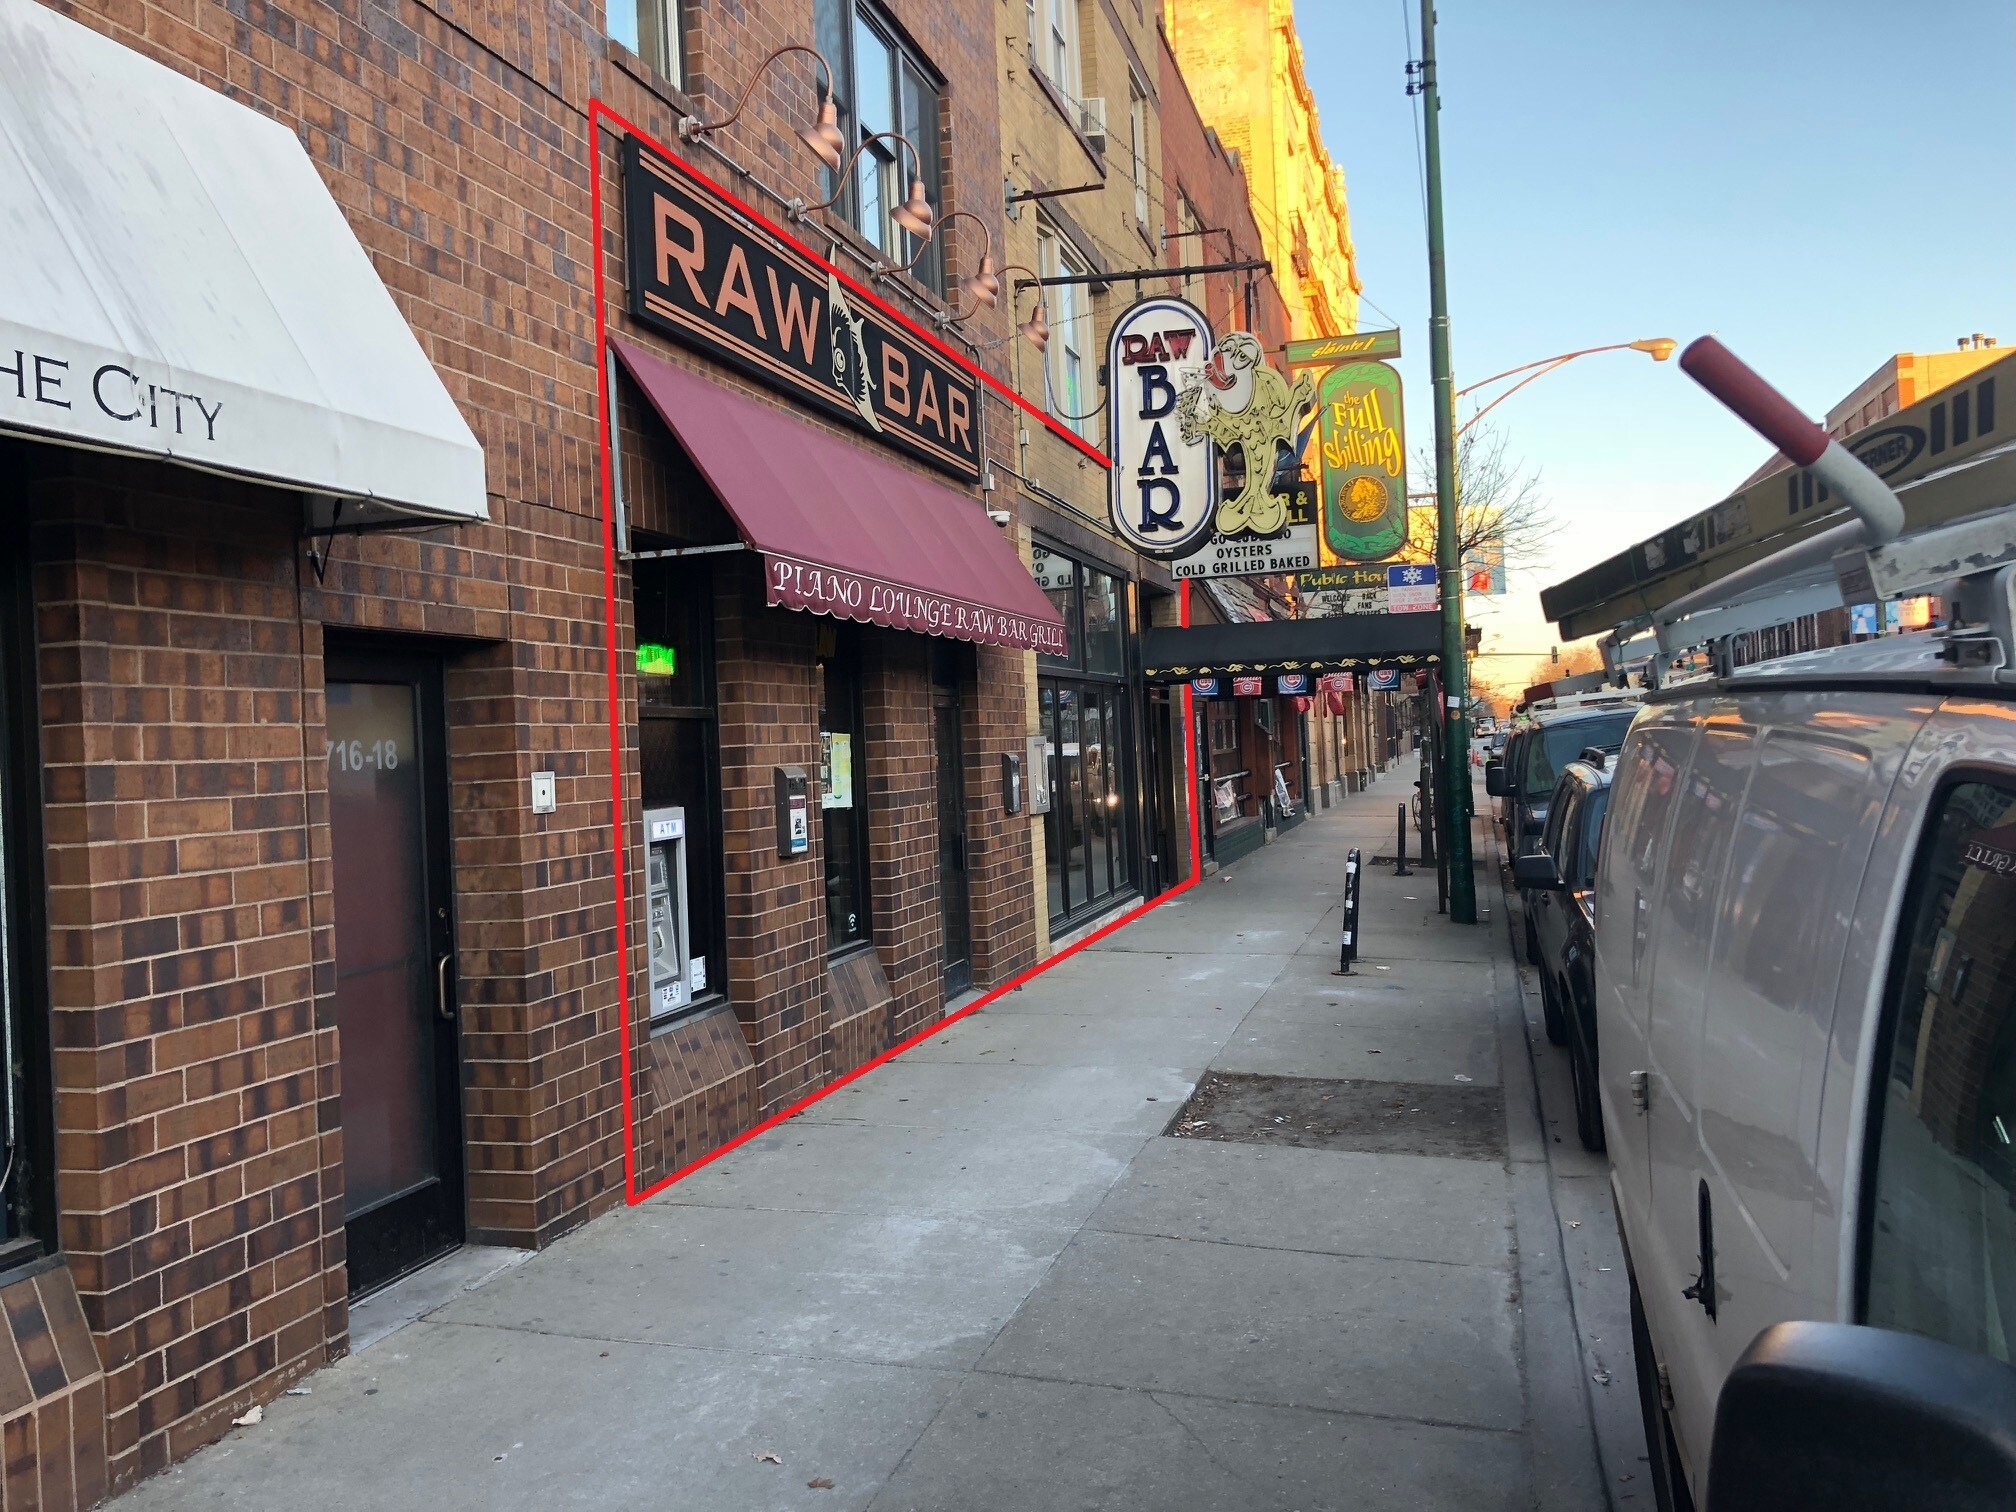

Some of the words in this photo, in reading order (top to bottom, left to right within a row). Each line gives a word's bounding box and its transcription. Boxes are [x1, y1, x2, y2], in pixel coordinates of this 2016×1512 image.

[653, 192, 820, 365] RAW
[881, 341, 973, 453] BAR
[1122, 328, 1196, 366] RAW
[93, 364, 223, 441] CITY
[1344, 390, 1360, 406] the
[1332, 388, 1387, 434] Full
[1137, 365, 1184, 533] BAR
[1217, 544, 1272, 559] OYSTERS
[1176, 565, 1205, 577] COLD
[1213, 560, 1265, 574] GRILLED
[1270, 556, 1310, 570] BAKED
[1300, 573, 1348, 587] Public
[773, 561, 862, 607] PIANO
[869, 585, 952, 628] LOUNGE
[955, 607, 994, 635] RAW
[997, 616, 1028, 641] BAR
[1029, 623, 1063, 648] GRILL
[1357, 601, 1372, 610] FANS
[1392, 604, 1409, 612] TOW
[1412, 603, 1434, 611] ZONE
[660, 822, 677, 834] ATM
